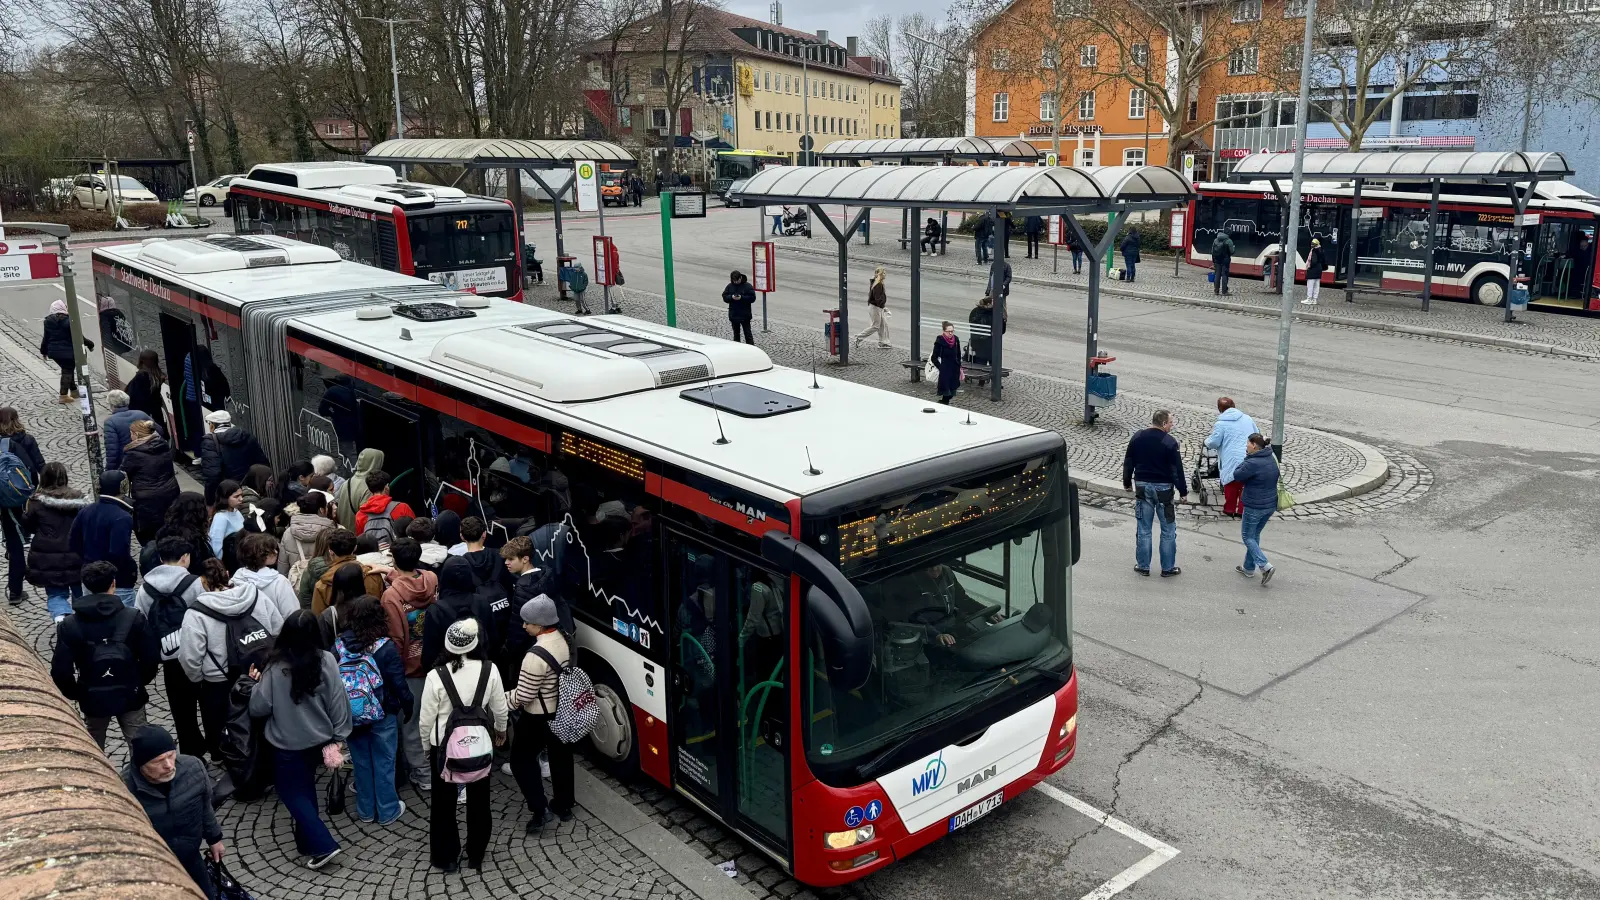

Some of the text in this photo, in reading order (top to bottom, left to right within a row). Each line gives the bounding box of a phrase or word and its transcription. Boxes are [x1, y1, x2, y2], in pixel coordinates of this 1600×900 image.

[1029, 123, 1103, 134] HOTE FISCHER
[1306, 193, 1337, 204] Dachau
[456, 219, 468, 230] 717
[1478, 213, 1488, 222] 722
[1434, 262, 1446, 271] im
[1446, 262, 1467, 273] MVV.
[120, 266, 171, 301] Stadtwerke Dachau
[736, 501, 766, 521] MAN
[490, 597, 510, 613] ANS
[239, 629, 268, 645] VANS
[912, 749, 942, 797] MVV
[957, 765, 997, 794] MAN
[954, 792, 1004, 828] DAH V 713
